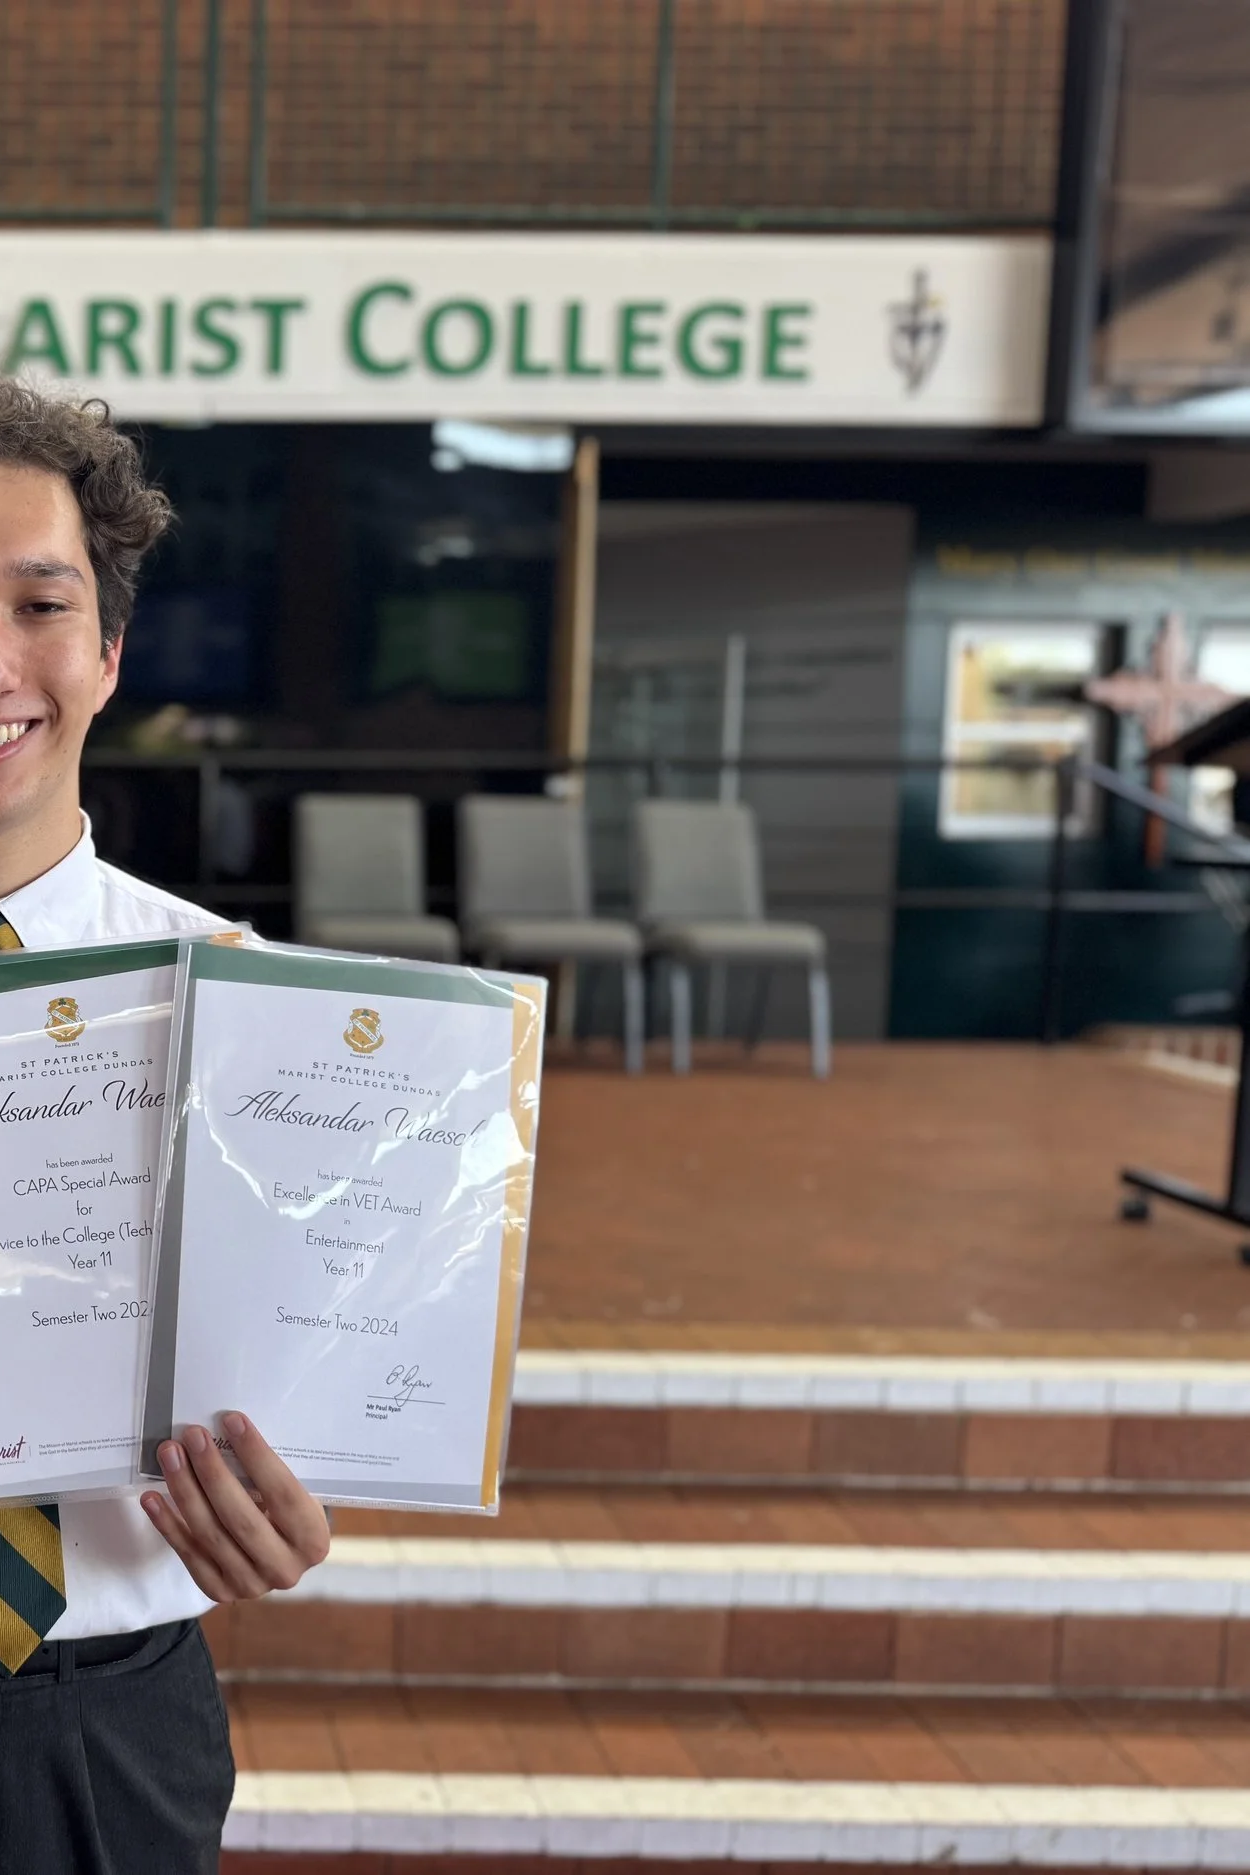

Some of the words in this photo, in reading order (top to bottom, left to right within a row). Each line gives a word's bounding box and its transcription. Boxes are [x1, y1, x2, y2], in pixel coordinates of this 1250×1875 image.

[345, 279, 814, 381] COLLEGE
[21, 1060, 36, 1069] ST
[44, 1050, 119, 1067] PATRICK'S
[41, 1064, 98, 1078] COLLEGE
[104, 1058, 154, 1070] DUNDAS
[312, 1061, 328, 1071] ST
[336, 1064, 411, 1081] PATRICK'S
[278, 1069, 326, 1081] MARIST
[330, 1075, 387, 1090] COLLEGE
[393, 1084, 441, 1097] DUNDAS
[224, 1090, 374, 1133] Aleksandar
[46, 1158, 58, 1169] has
[59, 1157, 80, 1168] been
[81, 1153, 113, 1166] awarded
[13, 1177, 59, 1197] CAPA
[61, 1172, 107, 1195] Special
[109, 1167, 151, 1186] Award
[317, 1169, 330, 1180] has
[351, 1174, 383, 1188] awarded
[76, 1201, 93, 1216] for
[340, 1194, 350, 1207] in
[353, 1192, 381, 1211] VET
[381, 1197, 422, 1217] Award
[26, 1235, 39, 1248] to
[41, 1232, 60, 1247] the
[62, 1226, 116, 1244] College
[305, 1229, 385, 1255] Entertainment
[67, 1253, 97, 1270] Year
[99, 1250, 113, 1268] 11
[322, 1258, 350, 1277] Year
[352, 1262, 365, 1278] 11
[32, 1309, 89, 1327] Semester
[91, 1305, 117, 1322] Two
[119, 1300, 153, 1320] 202
[275, 1306, 332, 1330] Semester
[334, 1313, 358, 1333] Two
[359, 1316, 399, 1337] 2024
[366, 1412, 388, 1420] Principal
[388, 1405, 402, 1413] Ryan
